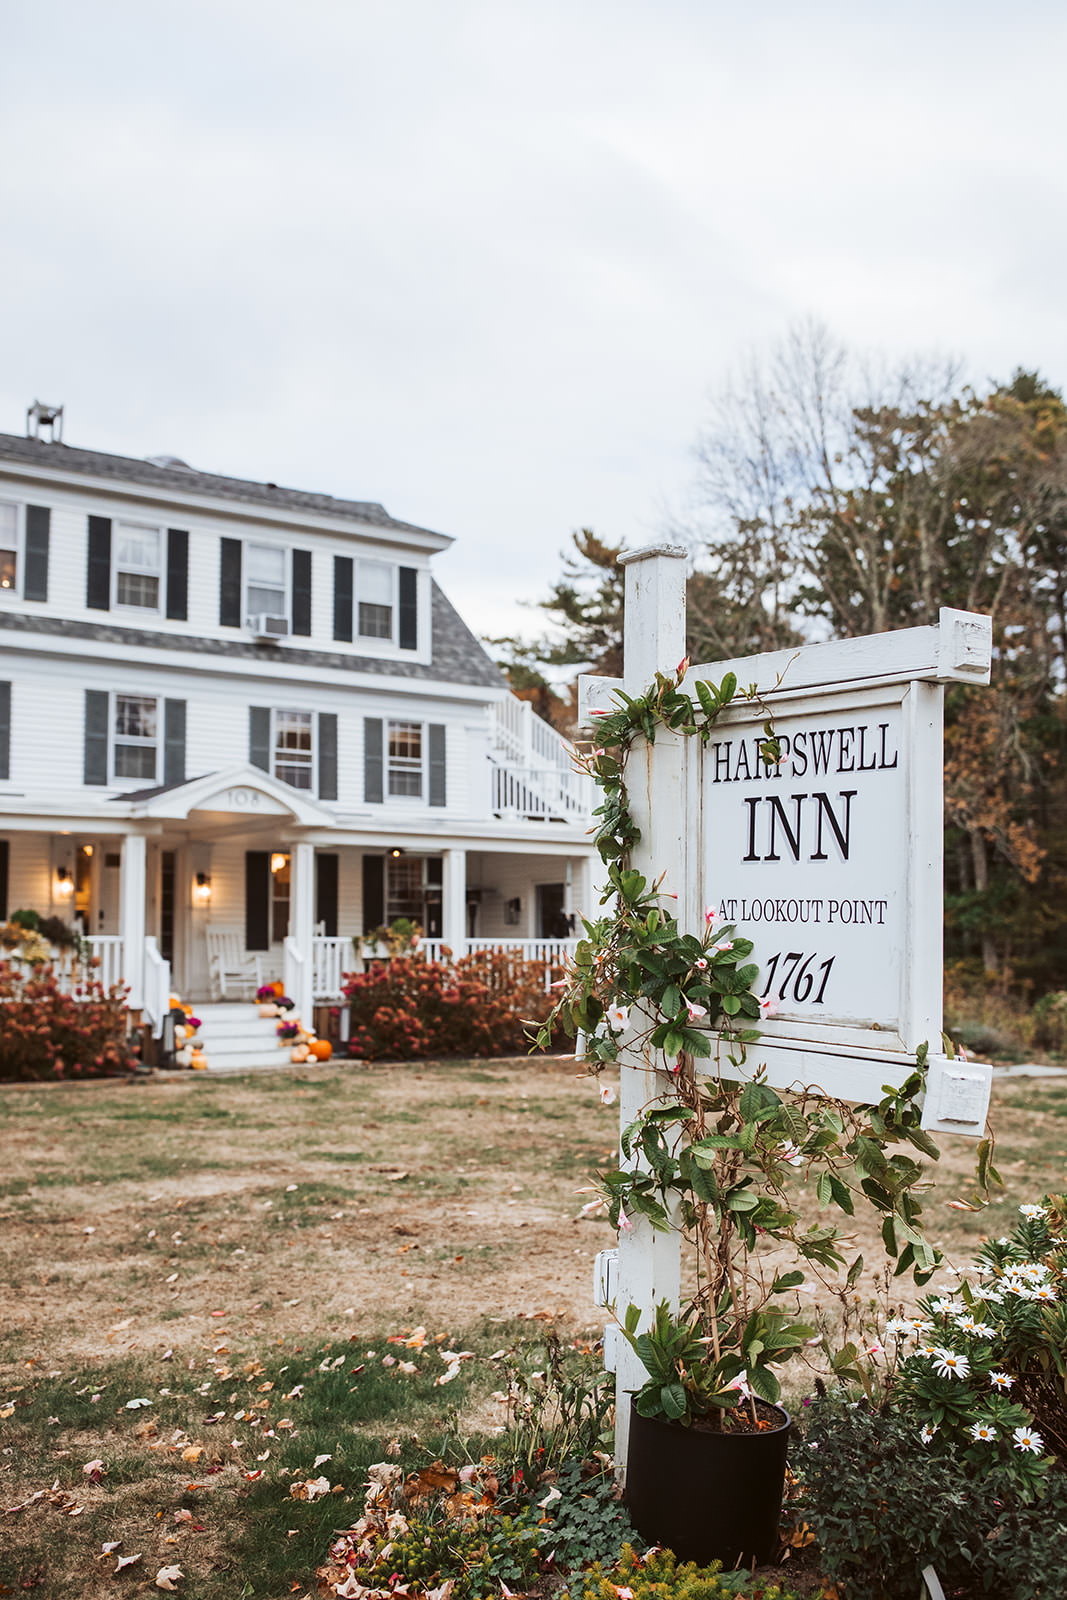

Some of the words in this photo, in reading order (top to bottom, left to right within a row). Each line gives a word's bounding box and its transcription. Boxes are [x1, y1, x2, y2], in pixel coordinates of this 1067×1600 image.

[743, 790, 858, 862] INN
[718, 899, 738, 921] AT
[741, 899, 823, 923] LOOKOUT
[828, 900, 888, 925] POINT
[760, 952, 836, 1004] 1761
